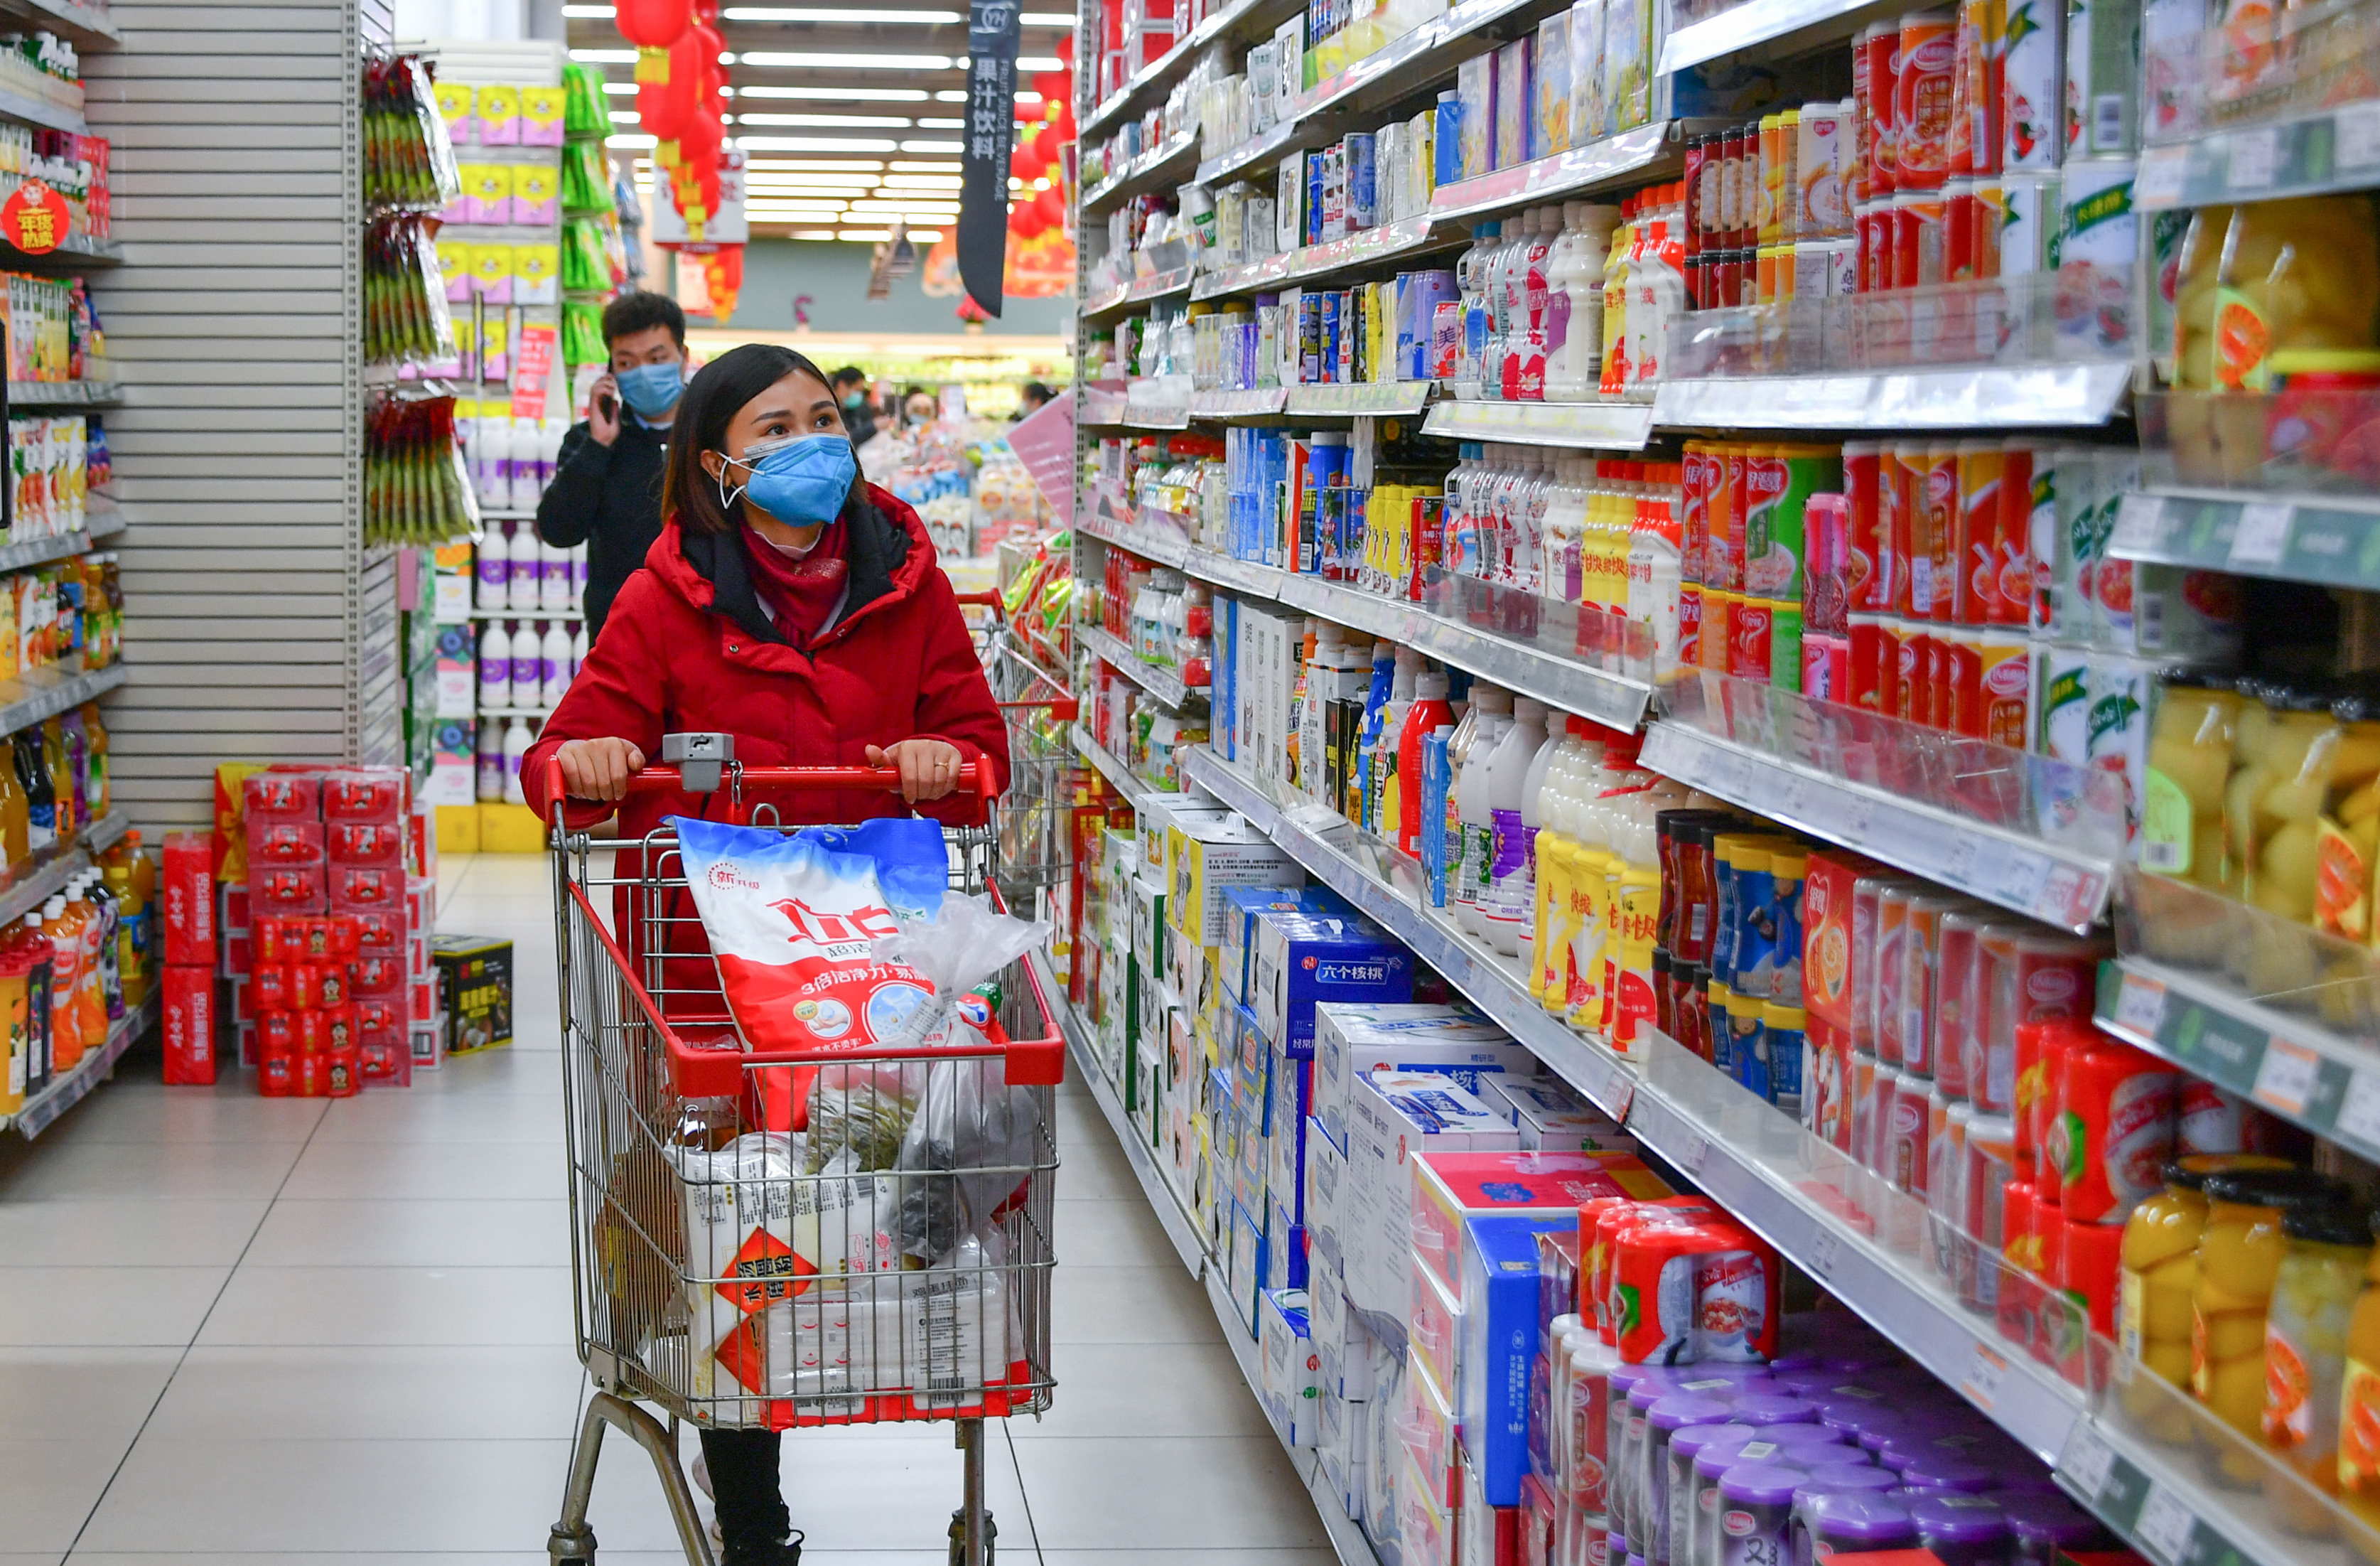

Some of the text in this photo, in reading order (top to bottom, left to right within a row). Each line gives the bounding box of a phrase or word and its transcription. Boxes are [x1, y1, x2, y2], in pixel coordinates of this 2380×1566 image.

[972, 58, 997, 160] 果汁饮料
[994, 58, 1009, 201] FRUIT JUICE BEVERAGE
[18, 215, 54, 232] 年货
[1322, 965, 1384, 980] 六个核桃
